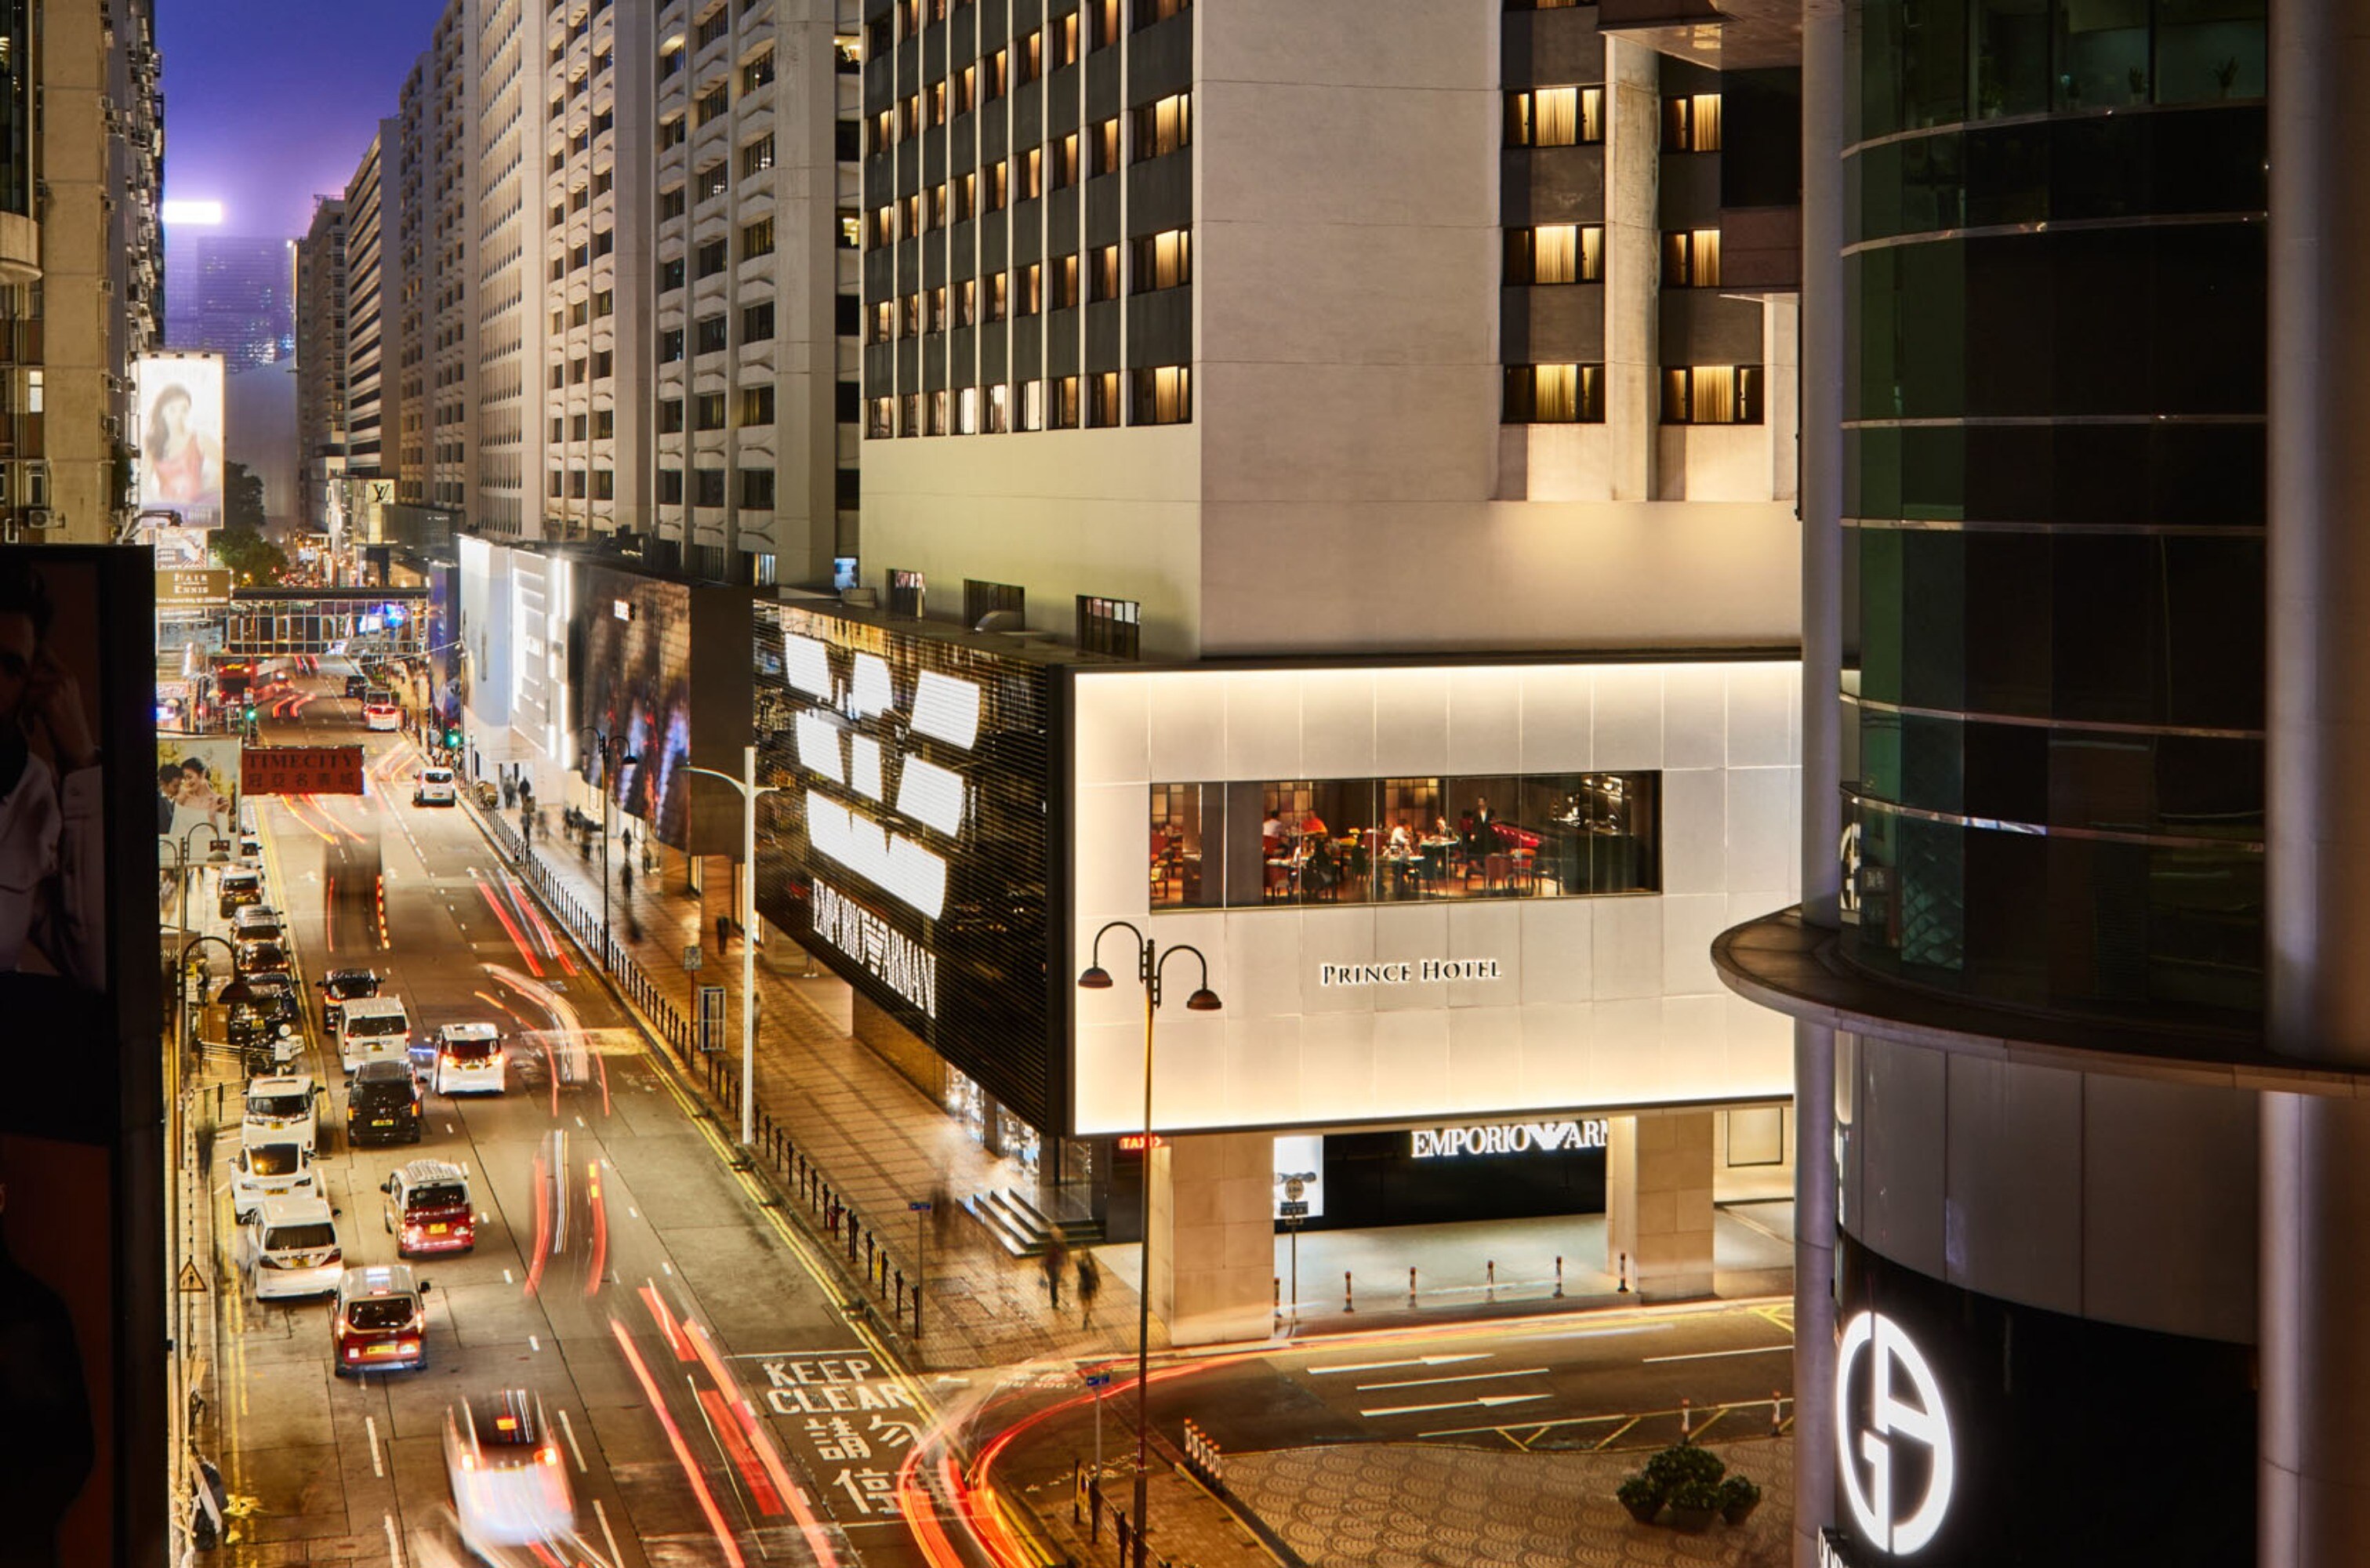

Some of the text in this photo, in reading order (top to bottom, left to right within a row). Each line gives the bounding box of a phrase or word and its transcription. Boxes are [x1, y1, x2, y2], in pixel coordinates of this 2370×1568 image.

[813, 877, 936, 1019] EMPORIO ARMANI
[1323, 960, 1502, 985] PRINCE HOTEL
[1411, 1123, 1530, 1158] EMPORIO
[763, 1359, 871, 1387] KEEP
[768, 1382, 916, 1414] CLEAR
[804, 1414, 927, 1461] 請勿
